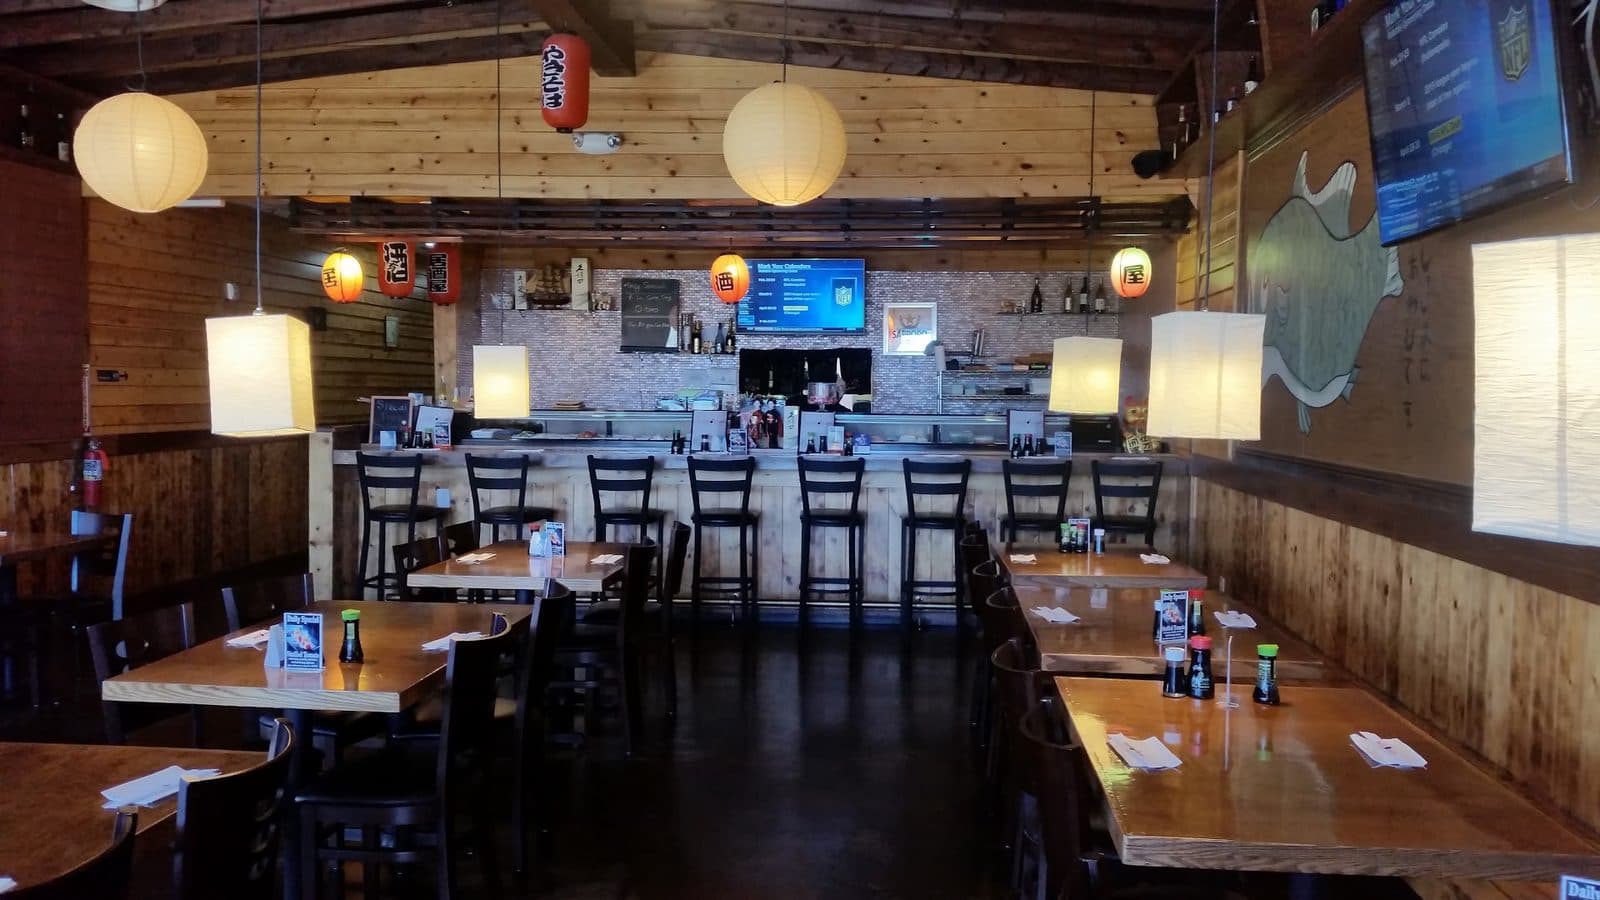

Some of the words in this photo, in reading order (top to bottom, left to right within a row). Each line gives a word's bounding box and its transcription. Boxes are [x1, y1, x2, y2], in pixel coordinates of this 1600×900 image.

[716, 272, 734, 291] 酒
[1124, 264, 1144, 285] 屋
[287, 615, 300, 624] Daily
[301, 615, 320, 624] Special
